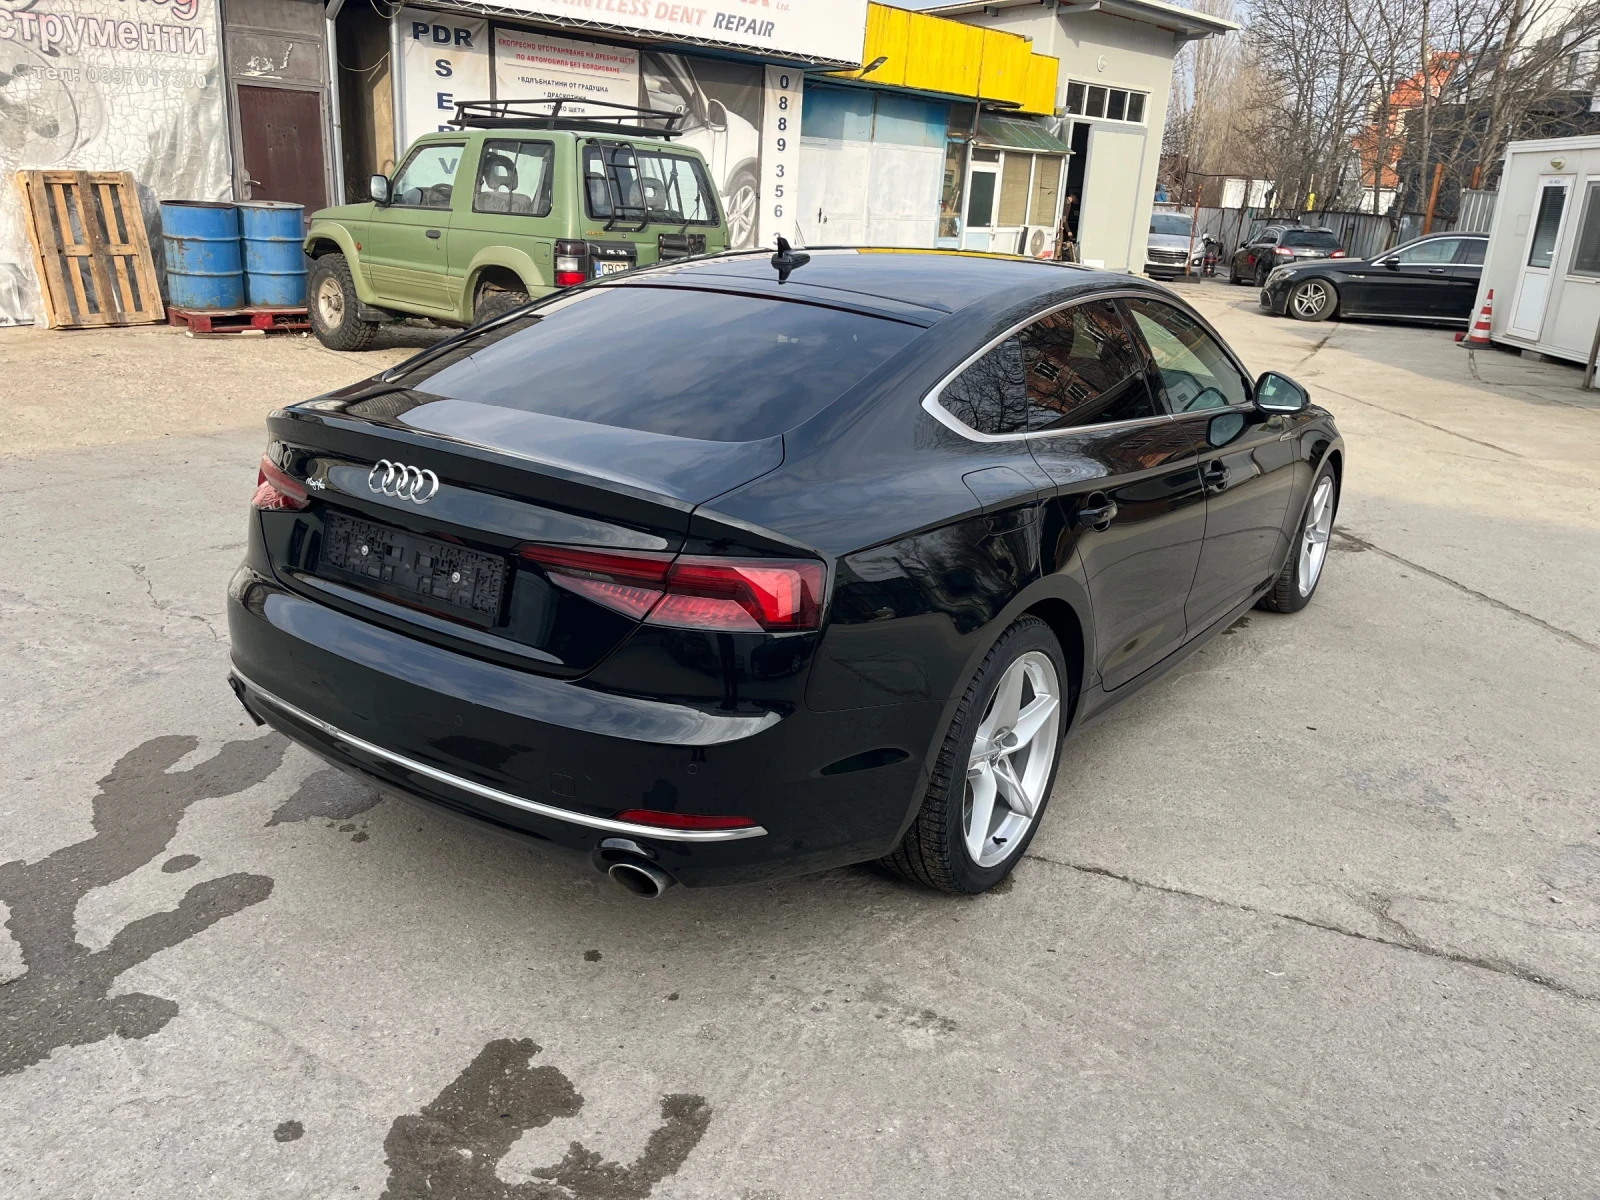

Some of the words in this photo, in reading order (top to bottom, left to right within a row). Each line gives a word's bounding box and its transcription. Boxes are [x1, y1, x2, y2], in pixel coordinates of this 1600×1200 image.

[655, 2, 708, 26] DENT
[712, 11, 775, 38] REPAIR
[412, 21, 473, 48] PDR
[498, 38, 536, 50] ЕКСПРЕСНО
[538, 44, 585, 57] ОТСТРАНЯВАНЕ
[595, 52, 618, 63] ДРЕБНИ
[619, 56, 635, 65] ЩЕТИ
[32, 65, 81, 82] тел:
[526, 55, 569, 67] АВТОМОБИЛА
[570, 61, 581, 69] БЕЗ
[582, 62, 621, 74] БОЯДИСВАНЕ
[521, 76, 567, 88] ВДЛЪБНАТИНИ
[578, 83, 609, 93] ГРАДУШКА
